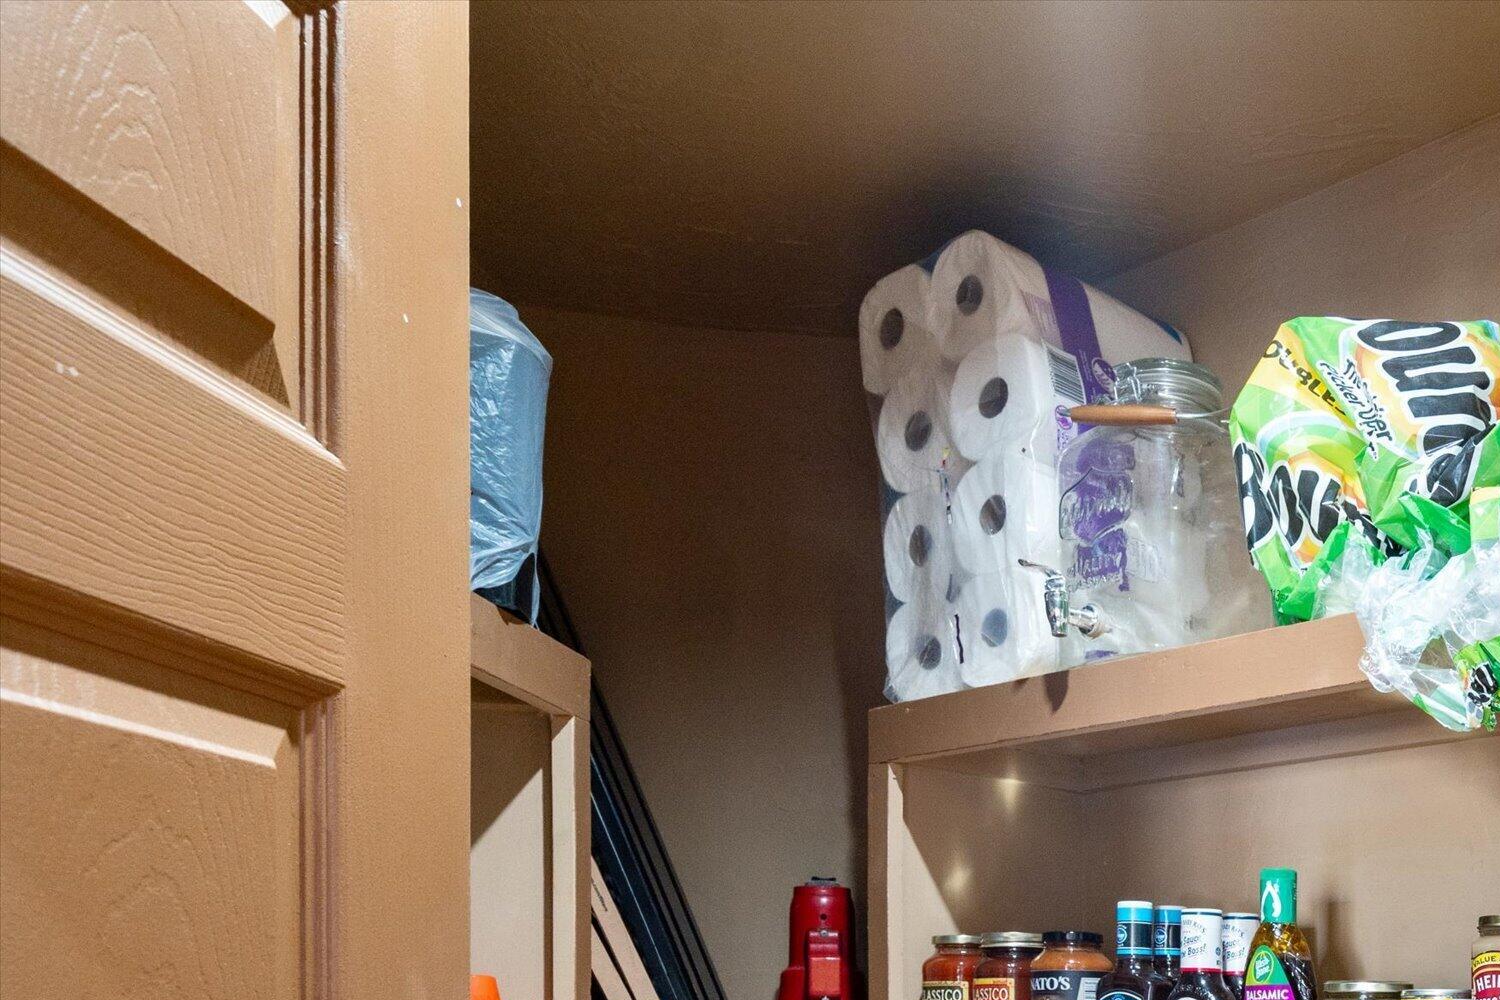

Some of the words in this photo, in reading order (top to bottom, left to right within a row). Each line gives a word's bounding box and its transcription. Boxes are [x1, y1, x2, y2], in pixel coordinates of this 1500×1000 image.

[1473, 955, 1497, 968] VALUE
[974, 987, 1009, 1000] LASSICO
[1246, 989, 1290, 1000] BALSAMIC
